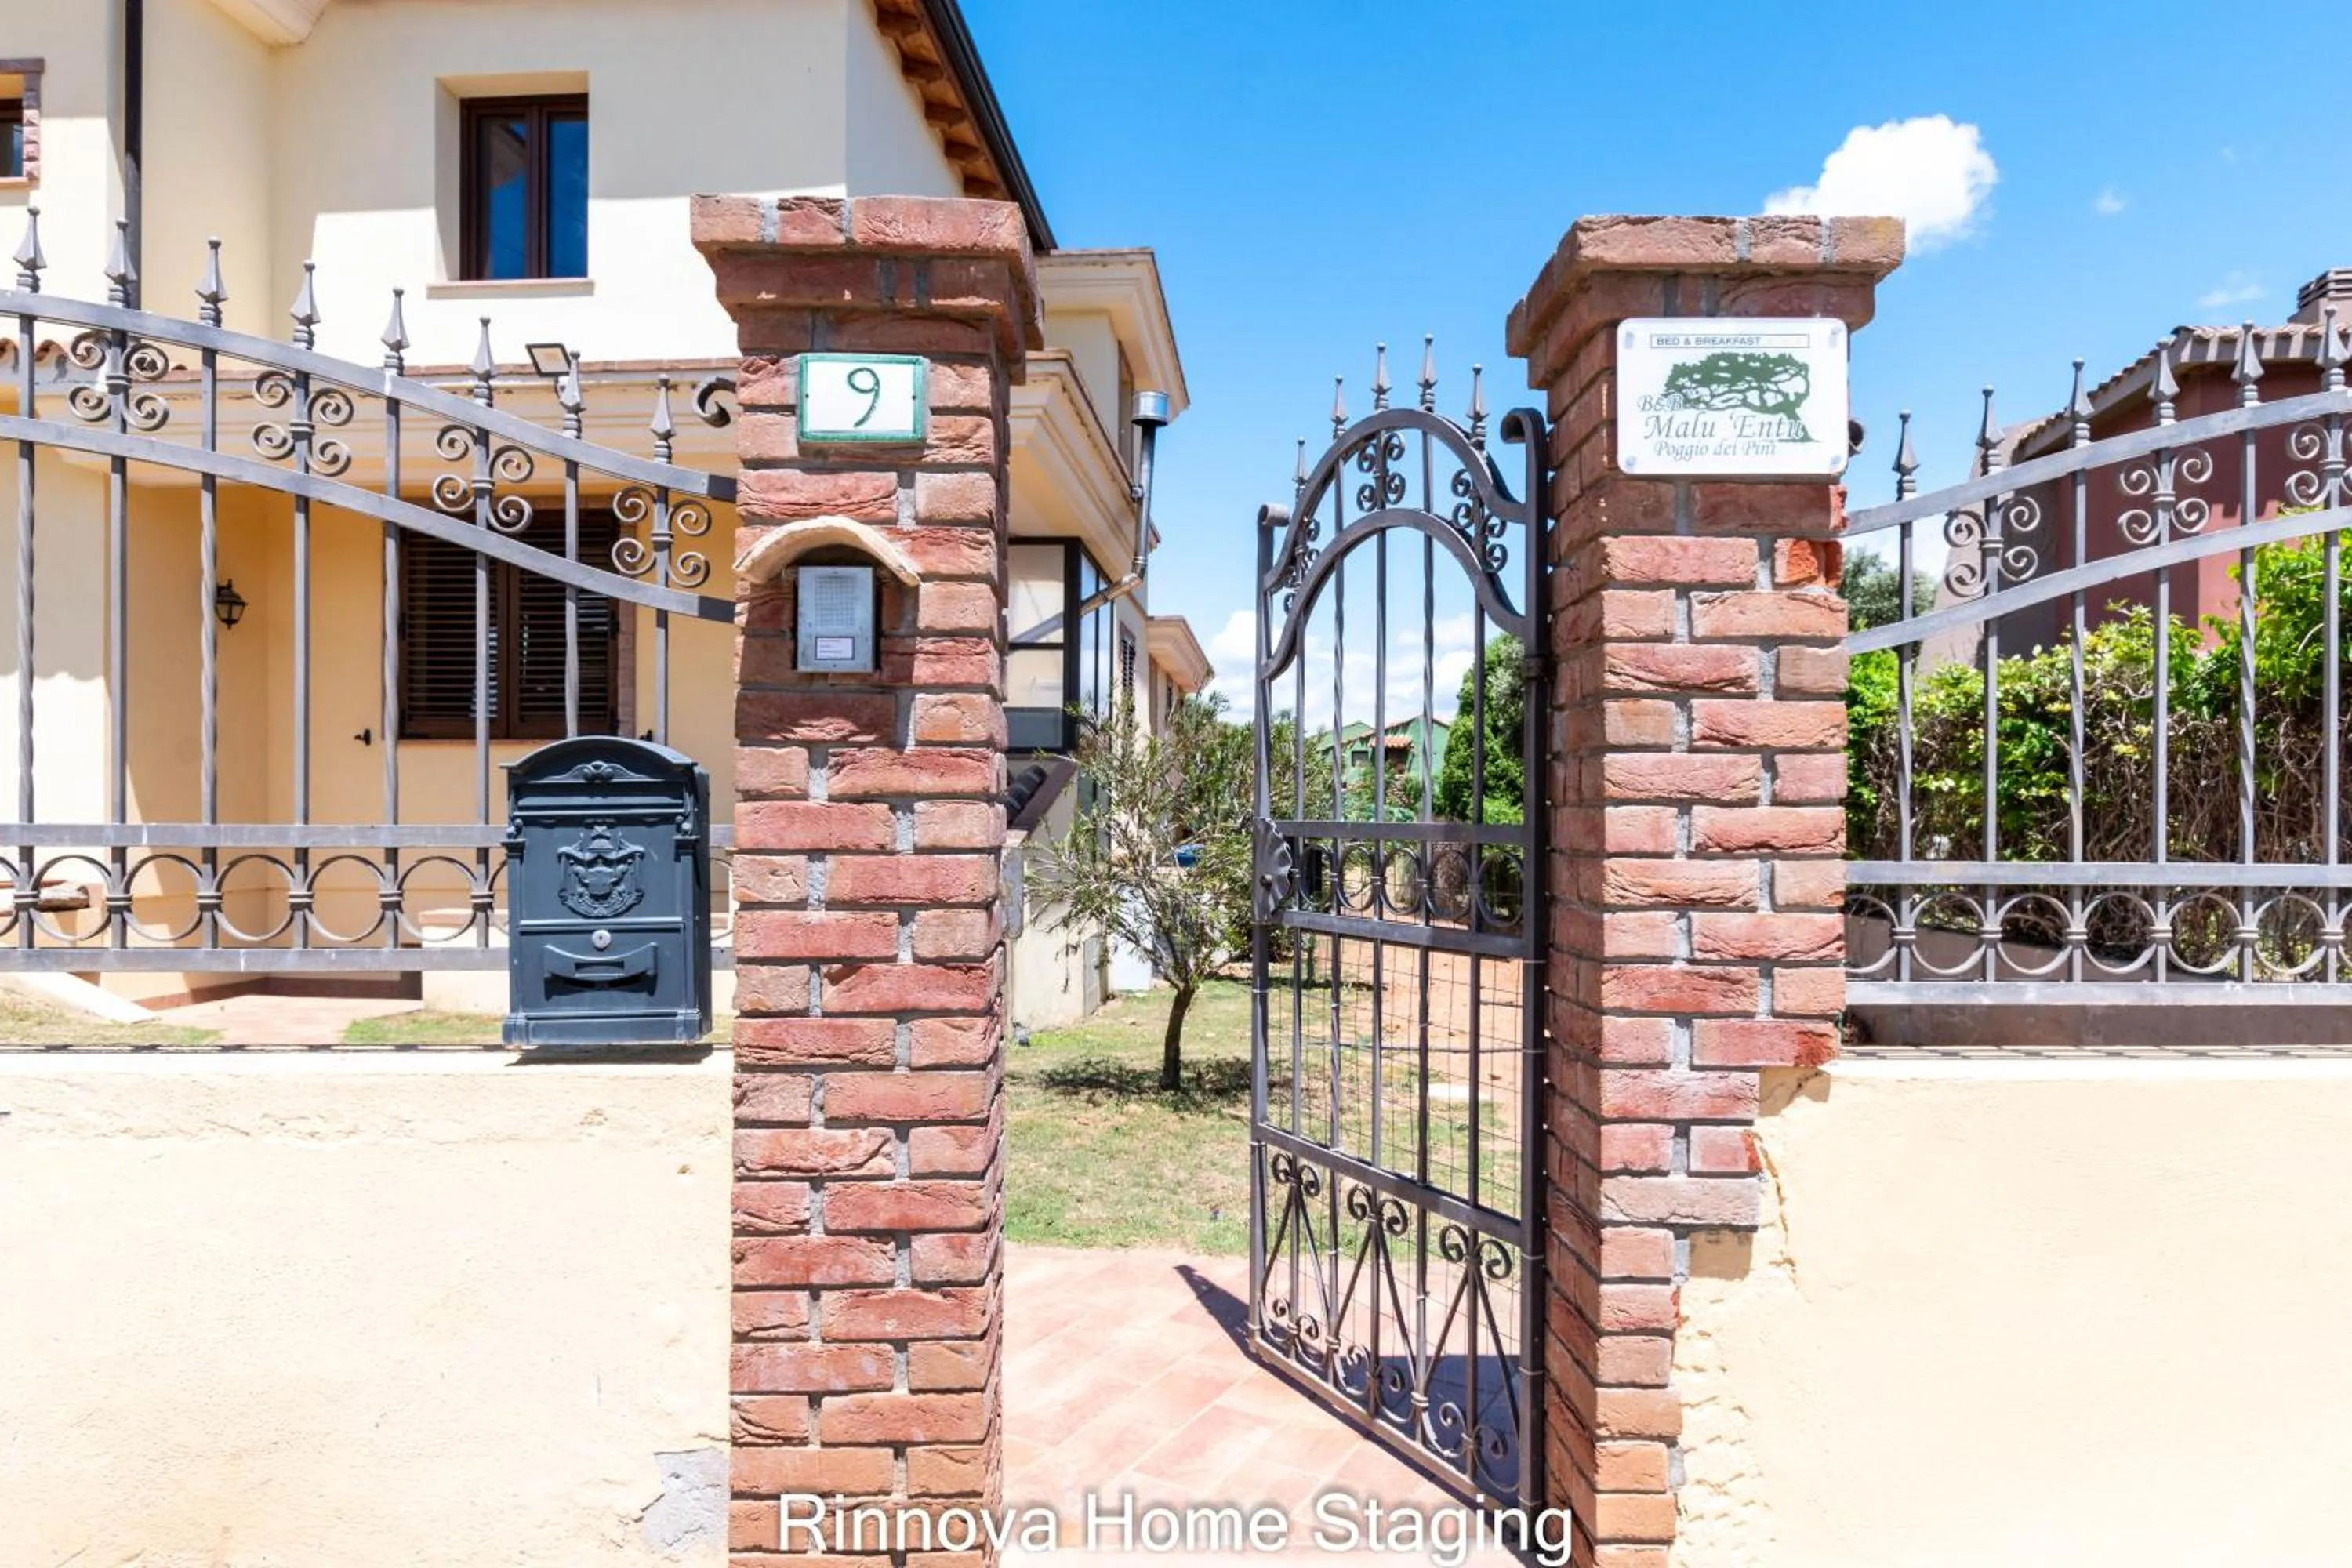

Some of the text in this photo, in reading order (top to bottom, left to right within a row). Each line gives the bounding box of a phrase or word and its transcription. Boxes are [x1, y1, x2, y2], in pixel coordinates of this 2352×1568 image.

[1656, 336, 1762, 346] BED & BREAKFAST
[847, 367, 880, 428] 9
[1637, 394, 1685, 412] B&B
[1643, 410, 1715, 440] Malu
[1654, 440, 1708, 462] Poggio
[1742, 439, 1777, 456] Pini
